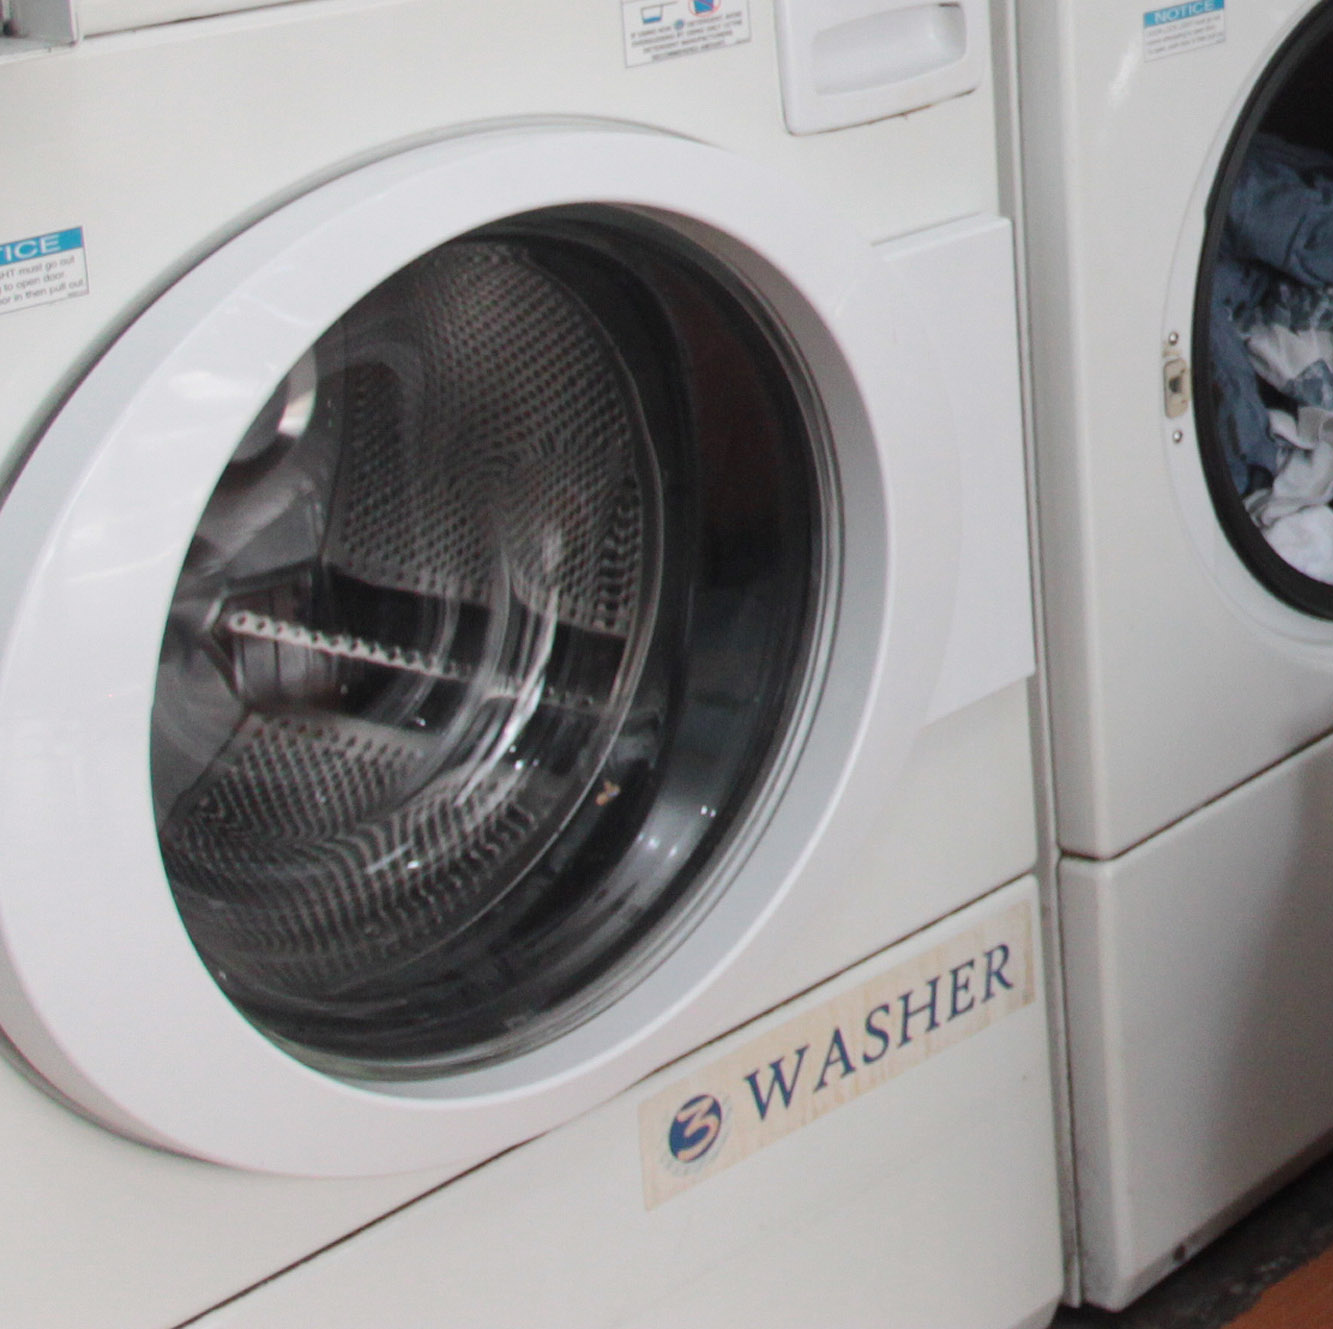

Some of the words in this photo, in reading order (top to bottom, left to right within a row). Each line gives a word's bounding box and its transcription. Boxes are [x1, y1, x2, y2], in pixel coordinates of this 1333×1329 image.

[1154, 0, 1215, 24] NOTICE
[0, 234, 60, 262] ICE
[676, 1095, 721, 1162] 3
[743, 943, 1014, 1122] WASHER
